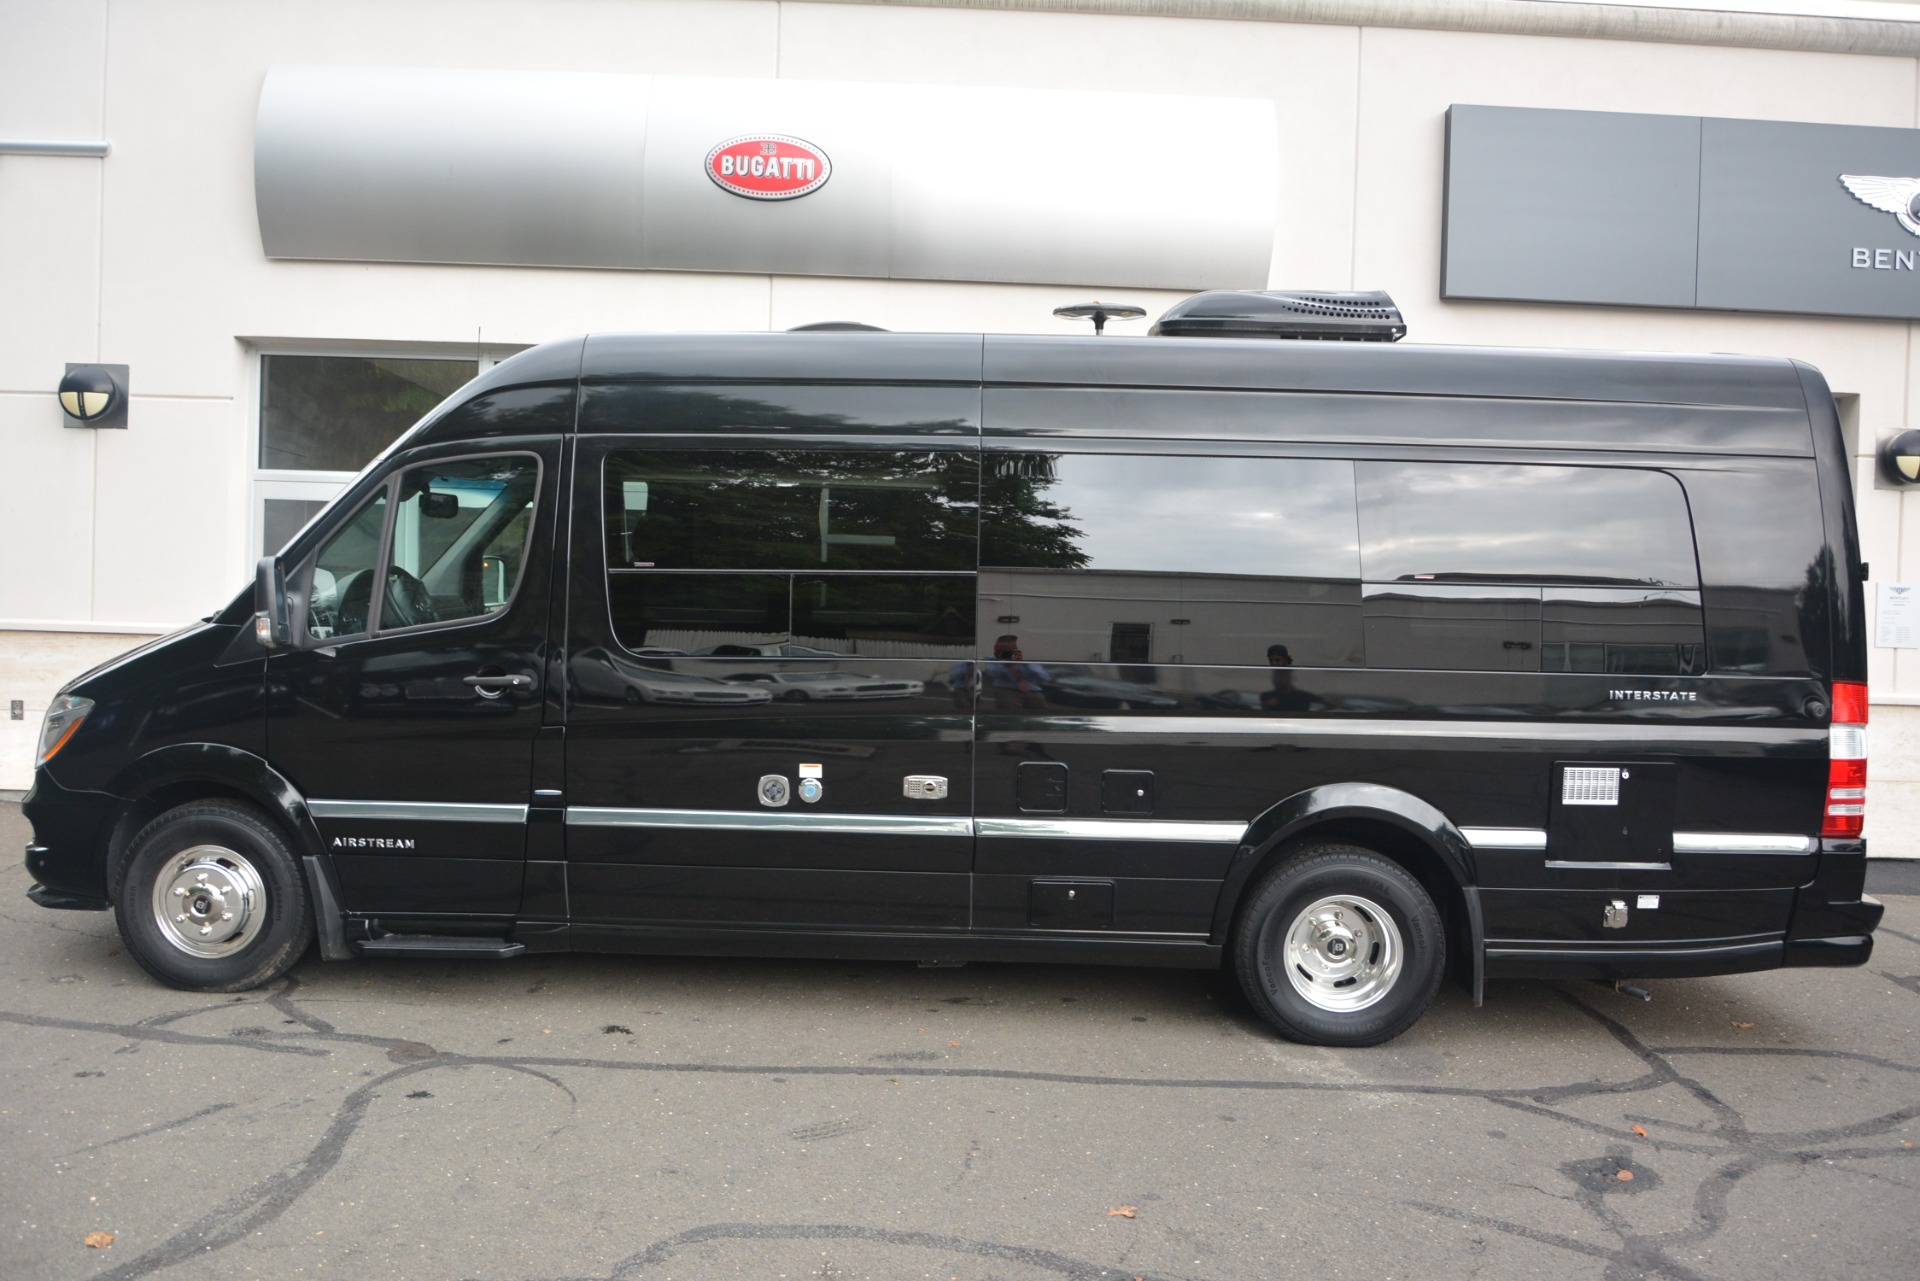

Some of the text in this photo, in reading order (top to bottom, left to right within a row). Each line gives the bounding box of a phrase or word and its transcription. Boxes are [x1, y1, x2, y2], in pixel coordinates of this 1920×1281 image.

[721, 155, 815, 180] BUGATTI
[1851, 247, 1920, 271] BEN
[1609, 690, 1697, 701] INTERSTATE
[332, 837, 415, 849] AIRSTREAM
